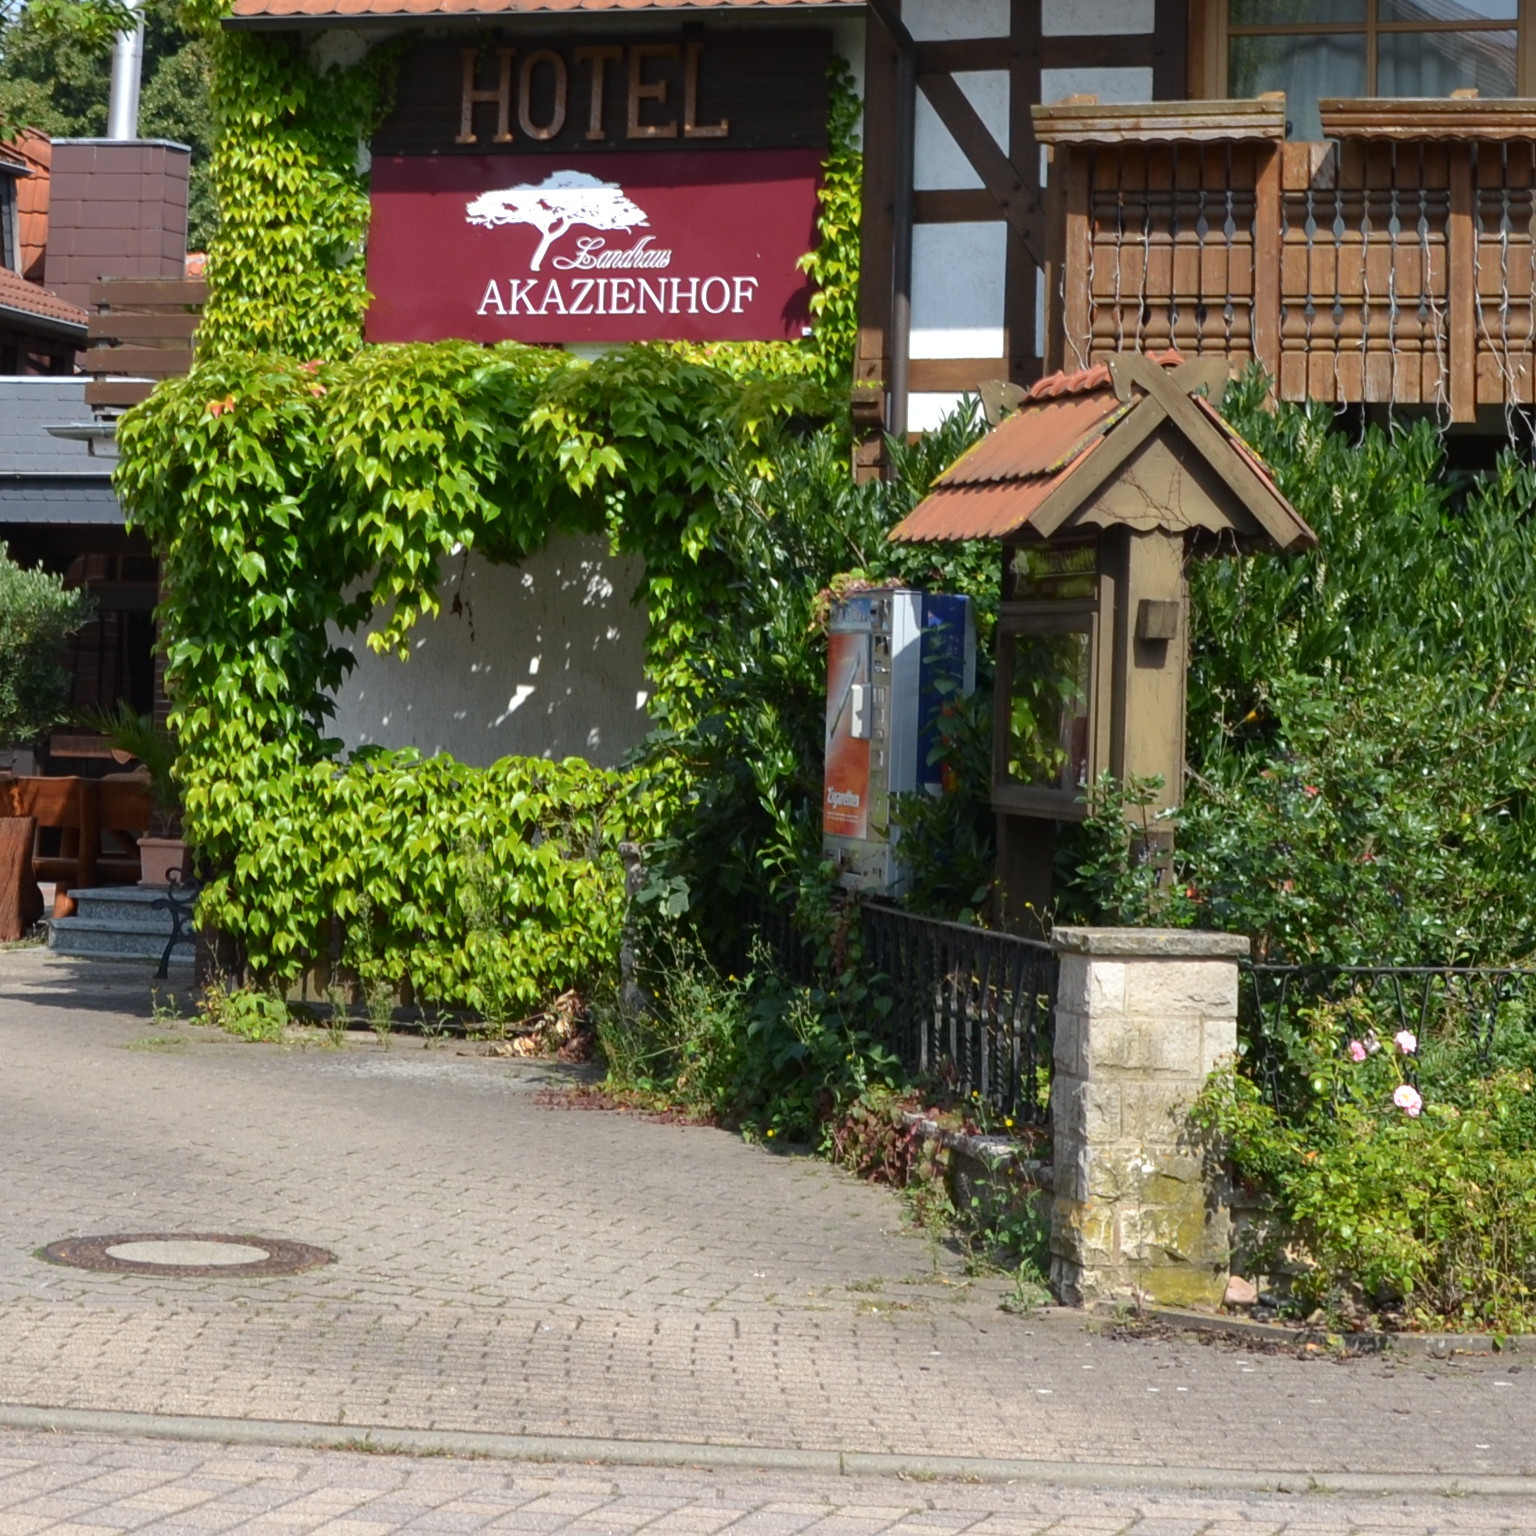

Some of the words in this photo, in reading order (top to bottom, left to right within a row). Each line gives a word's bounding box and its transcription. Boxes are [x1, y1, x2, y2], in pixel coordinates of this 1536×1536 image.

[455, 42, 729, 144] HOTEL
[552, 235, 673, 270] Landhaus
[476, 276, 760, 316] AKAZIENHOF
